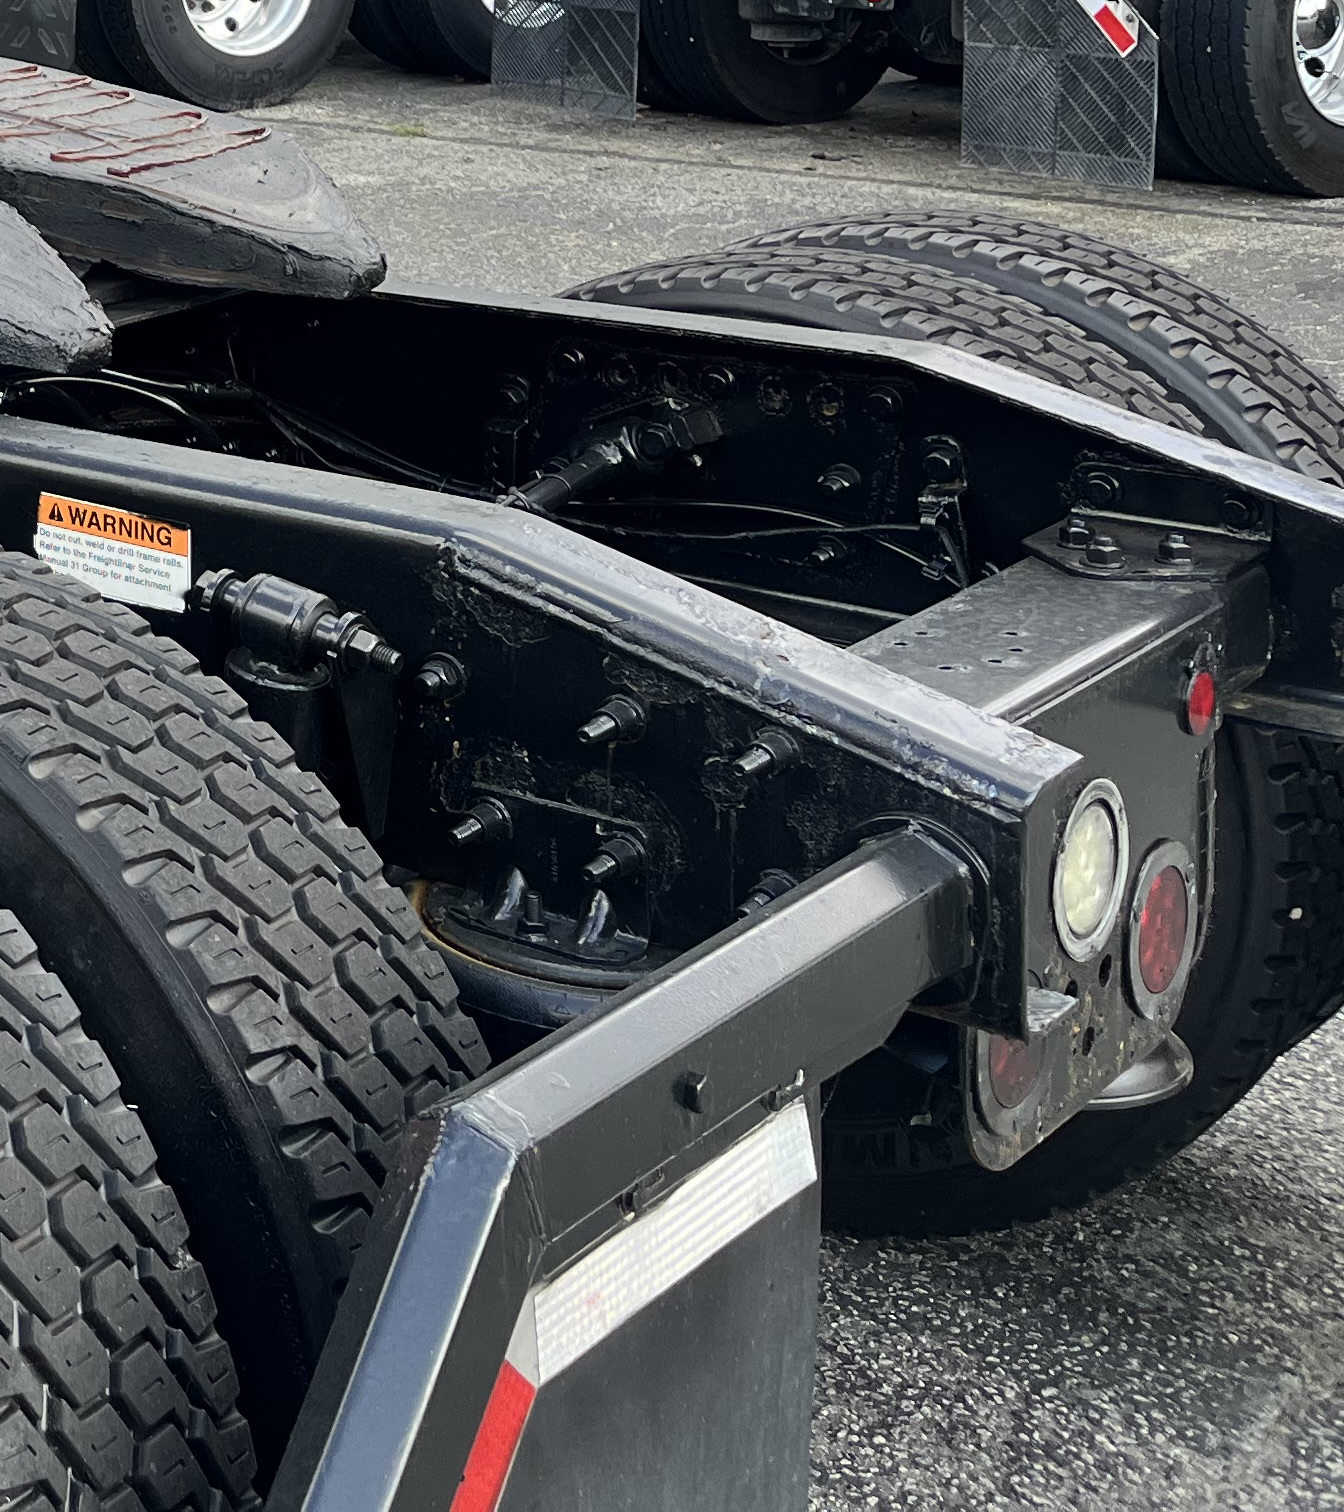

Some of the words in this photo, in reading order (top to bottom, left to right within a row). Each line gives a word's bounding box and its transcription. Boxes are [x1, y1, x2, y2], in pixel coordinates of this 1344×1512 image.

[67, 505, 172, 548] WARNING
[39, 527, 51, 538] Do
[52, 531, 66, 541] not
[85, 539, 105, 550] weld
[106, 544, 115, 553] or
[117, 546, 134, 558] drill
[135, 549, 161, 564] frame
[162, 554, 184, 569] rails.
[39, 540, 60, 553] Refer
[62, 545, 71, 555] to
[72, 547, 87, 559] the
[88, 552, 136, 571] Freightliner
[138, 563, 171, 579] Service
[39, 554, 69, 567] Manual
[70, 560, 80, 571] 31
[82, 563, 109, 578] Group
[110, 569, 123, 580] for
[123, 574, 172, 593] attachment
